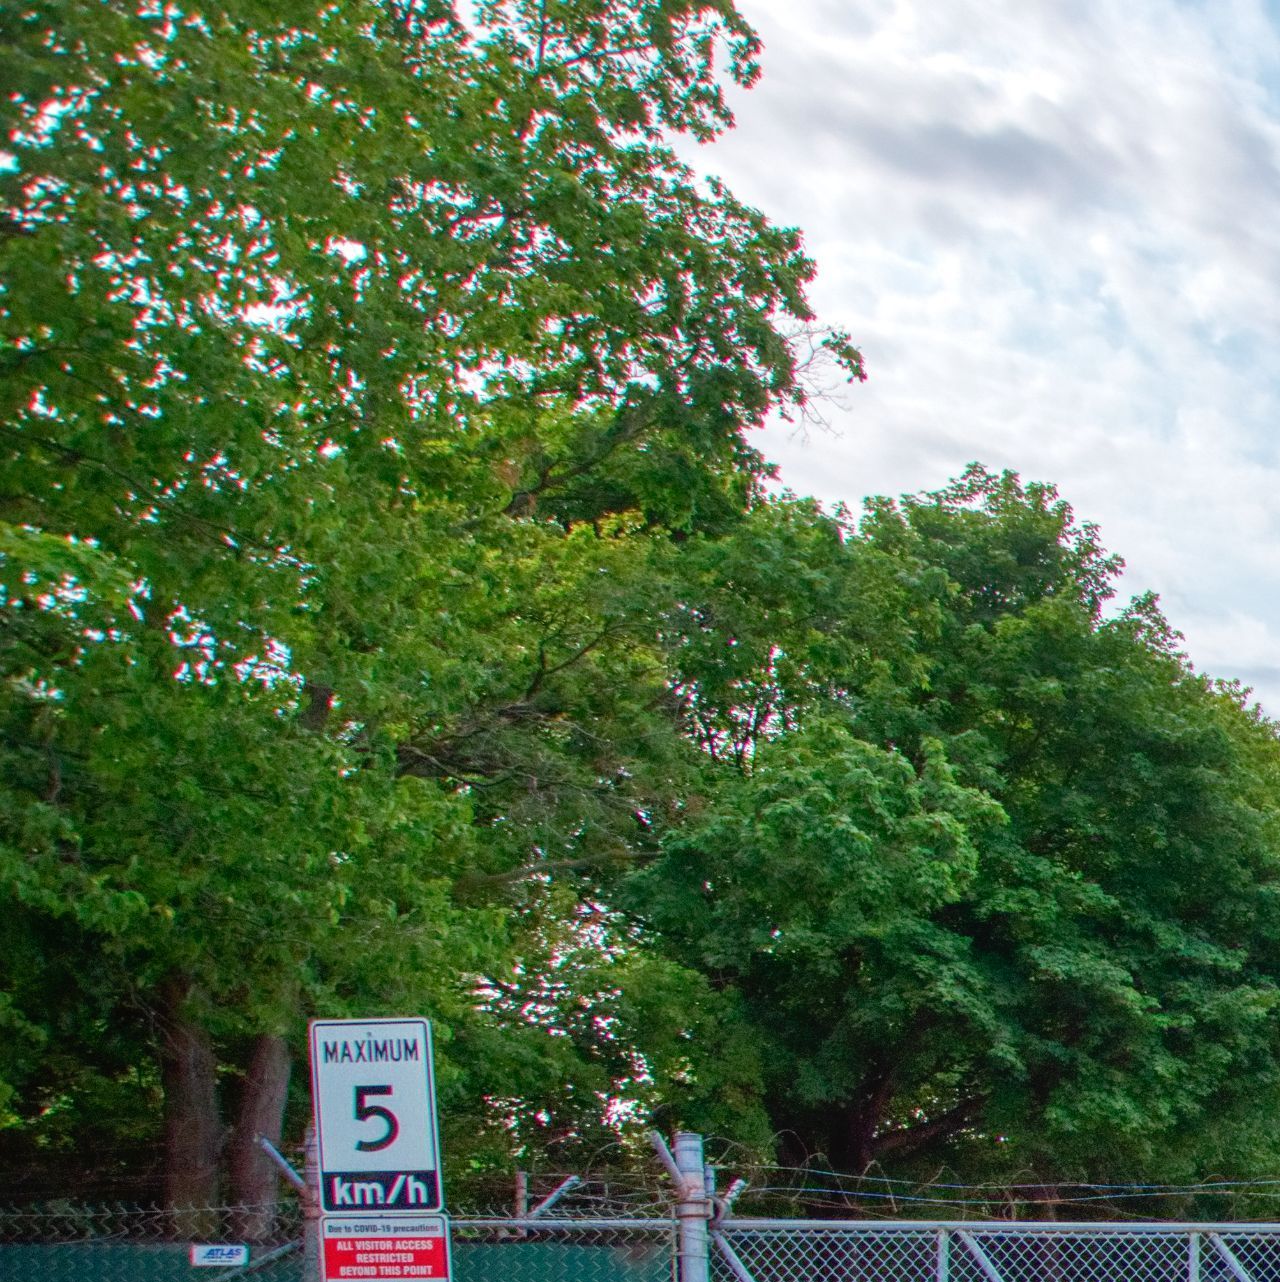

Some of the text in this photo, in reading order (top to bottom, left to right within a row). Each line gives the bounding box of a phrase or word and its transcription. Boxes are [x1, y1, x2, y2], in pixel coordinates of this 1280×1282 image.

[324, 1039, 419, 1063] MAXIMUM
[355, 1085, 400, 1152] 5
[332, 1174, 429, 1205] km/h
[344, 1225, 352, 1233] to
[354, 1224, 391, 1233] COVID-19
[393, 1224, 439, 1234] precautions
[337, 1240, 433, 1251] ALL VISITOR ACCESS
[206, 1248, 242, 1256] ATLAS
[356, 1253, 414, 1263] RESTRICTED
[340, 1265, 432, 1276] BEYOND THIS POINT
